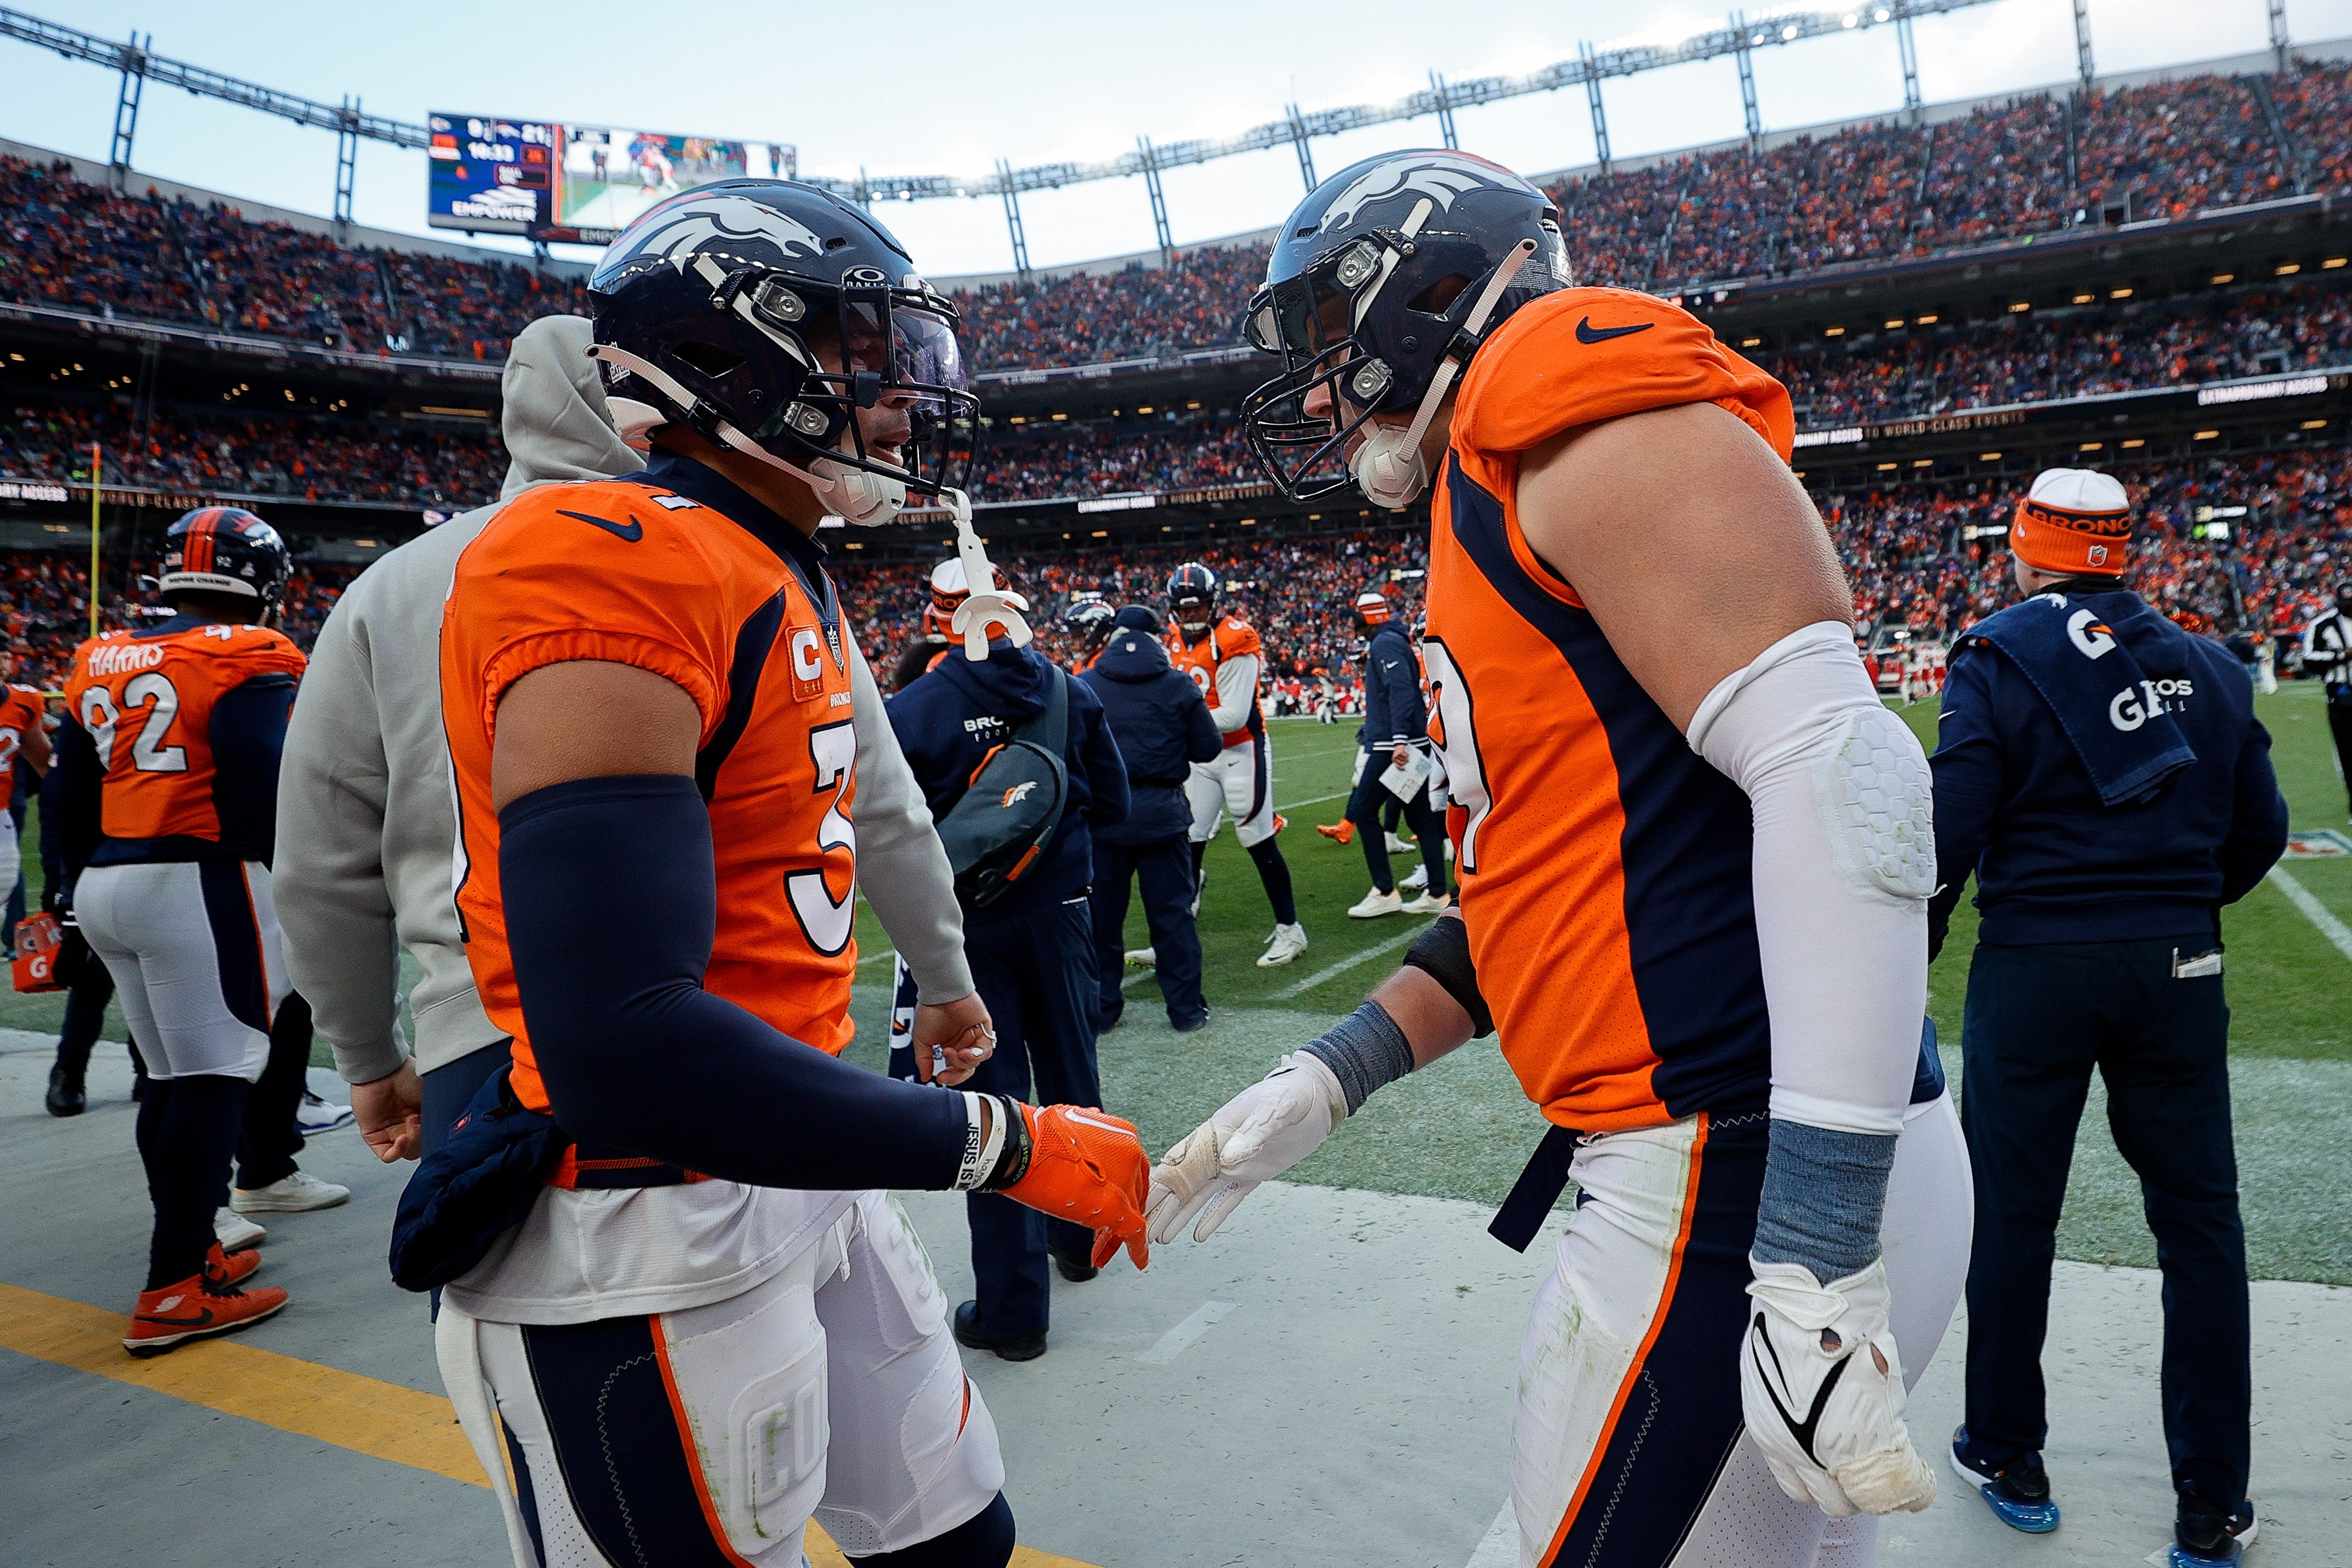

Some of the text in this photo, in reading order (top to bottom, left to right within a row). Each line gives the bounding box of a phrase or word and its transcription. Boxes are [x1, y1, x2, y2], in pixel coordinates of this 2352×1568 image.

[452, 200, 537, 222] EMPOWER
[89, 643, 164, 678] HARRIS
[792, 629, 822, 681] C
[2155, 679, 2194, 696] OS
[81, 672, 189, 771] 92
[783, 718, 857, 957] 3
[29, 955, 48, 979] G
[964, 1122, 980, 1165] JESUS
[961, 1169, 975, 1181] IS
